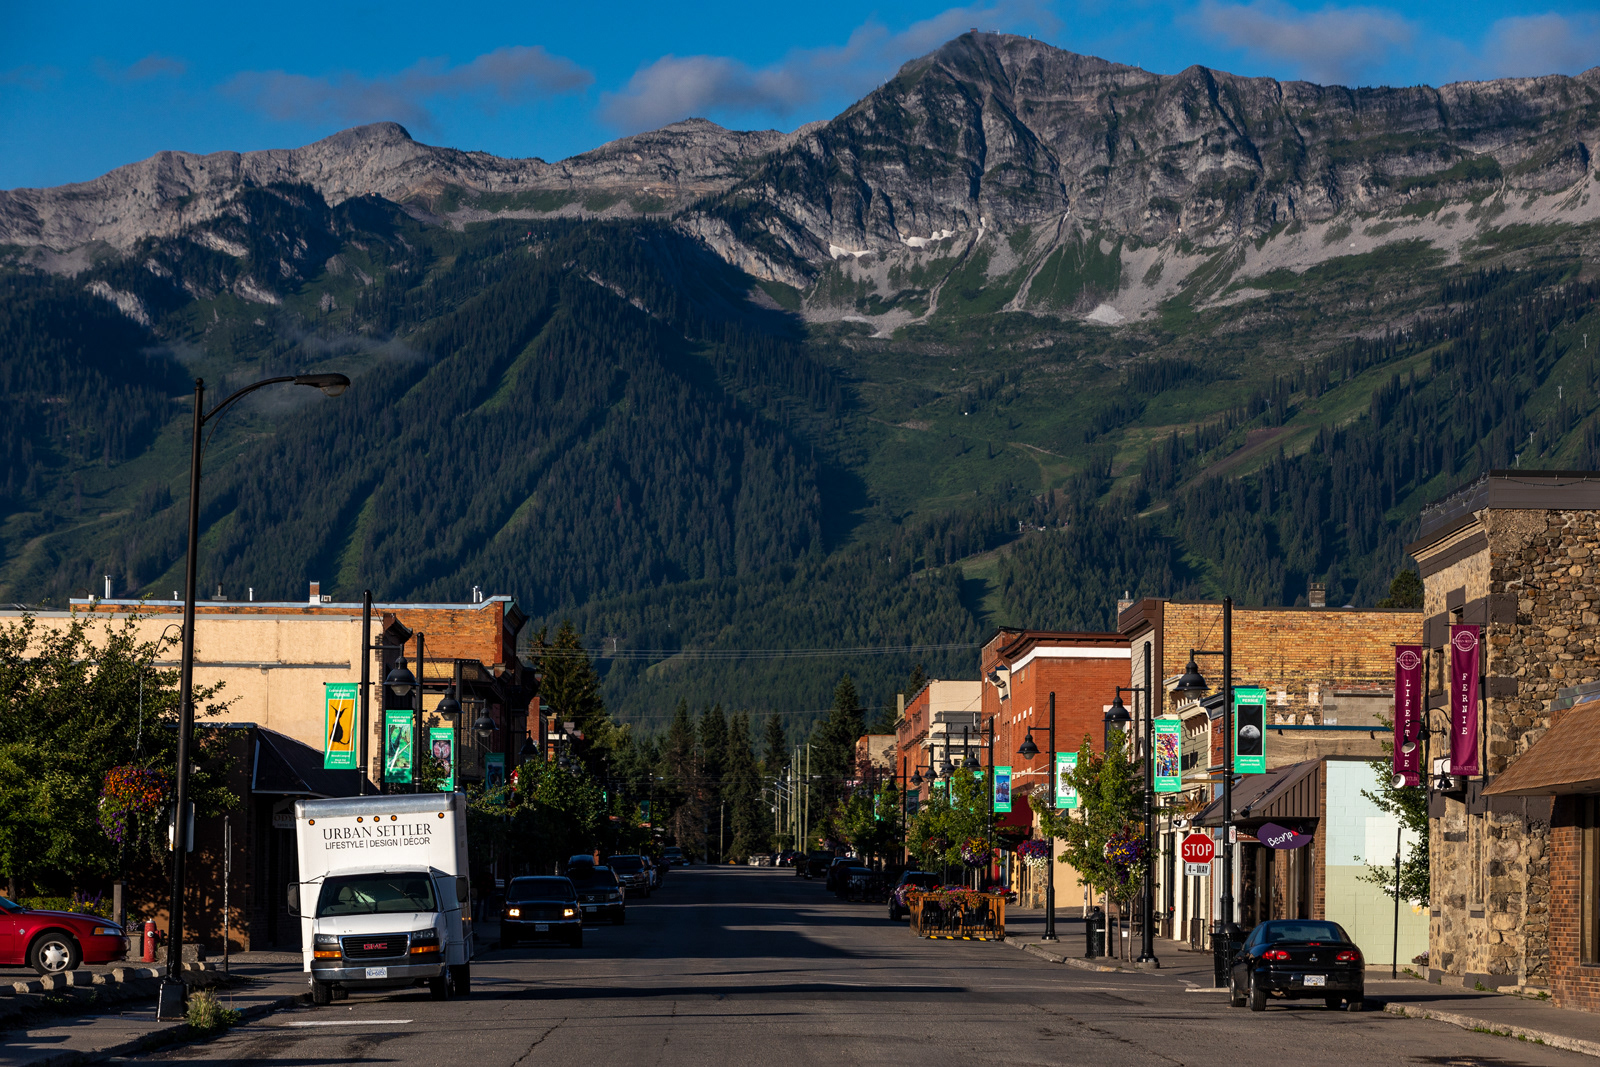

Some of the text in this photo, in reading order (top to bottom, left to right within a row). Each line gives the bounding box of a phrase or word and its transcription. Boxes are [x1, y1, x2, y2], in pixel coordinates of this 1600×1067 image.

[323, 823, 432, 840] URBAN SETTLER
[325, 836, 431, 850] LIFESTYLE DESIGN DÉCOR
[1184, 844, 1212, 856] STOP
